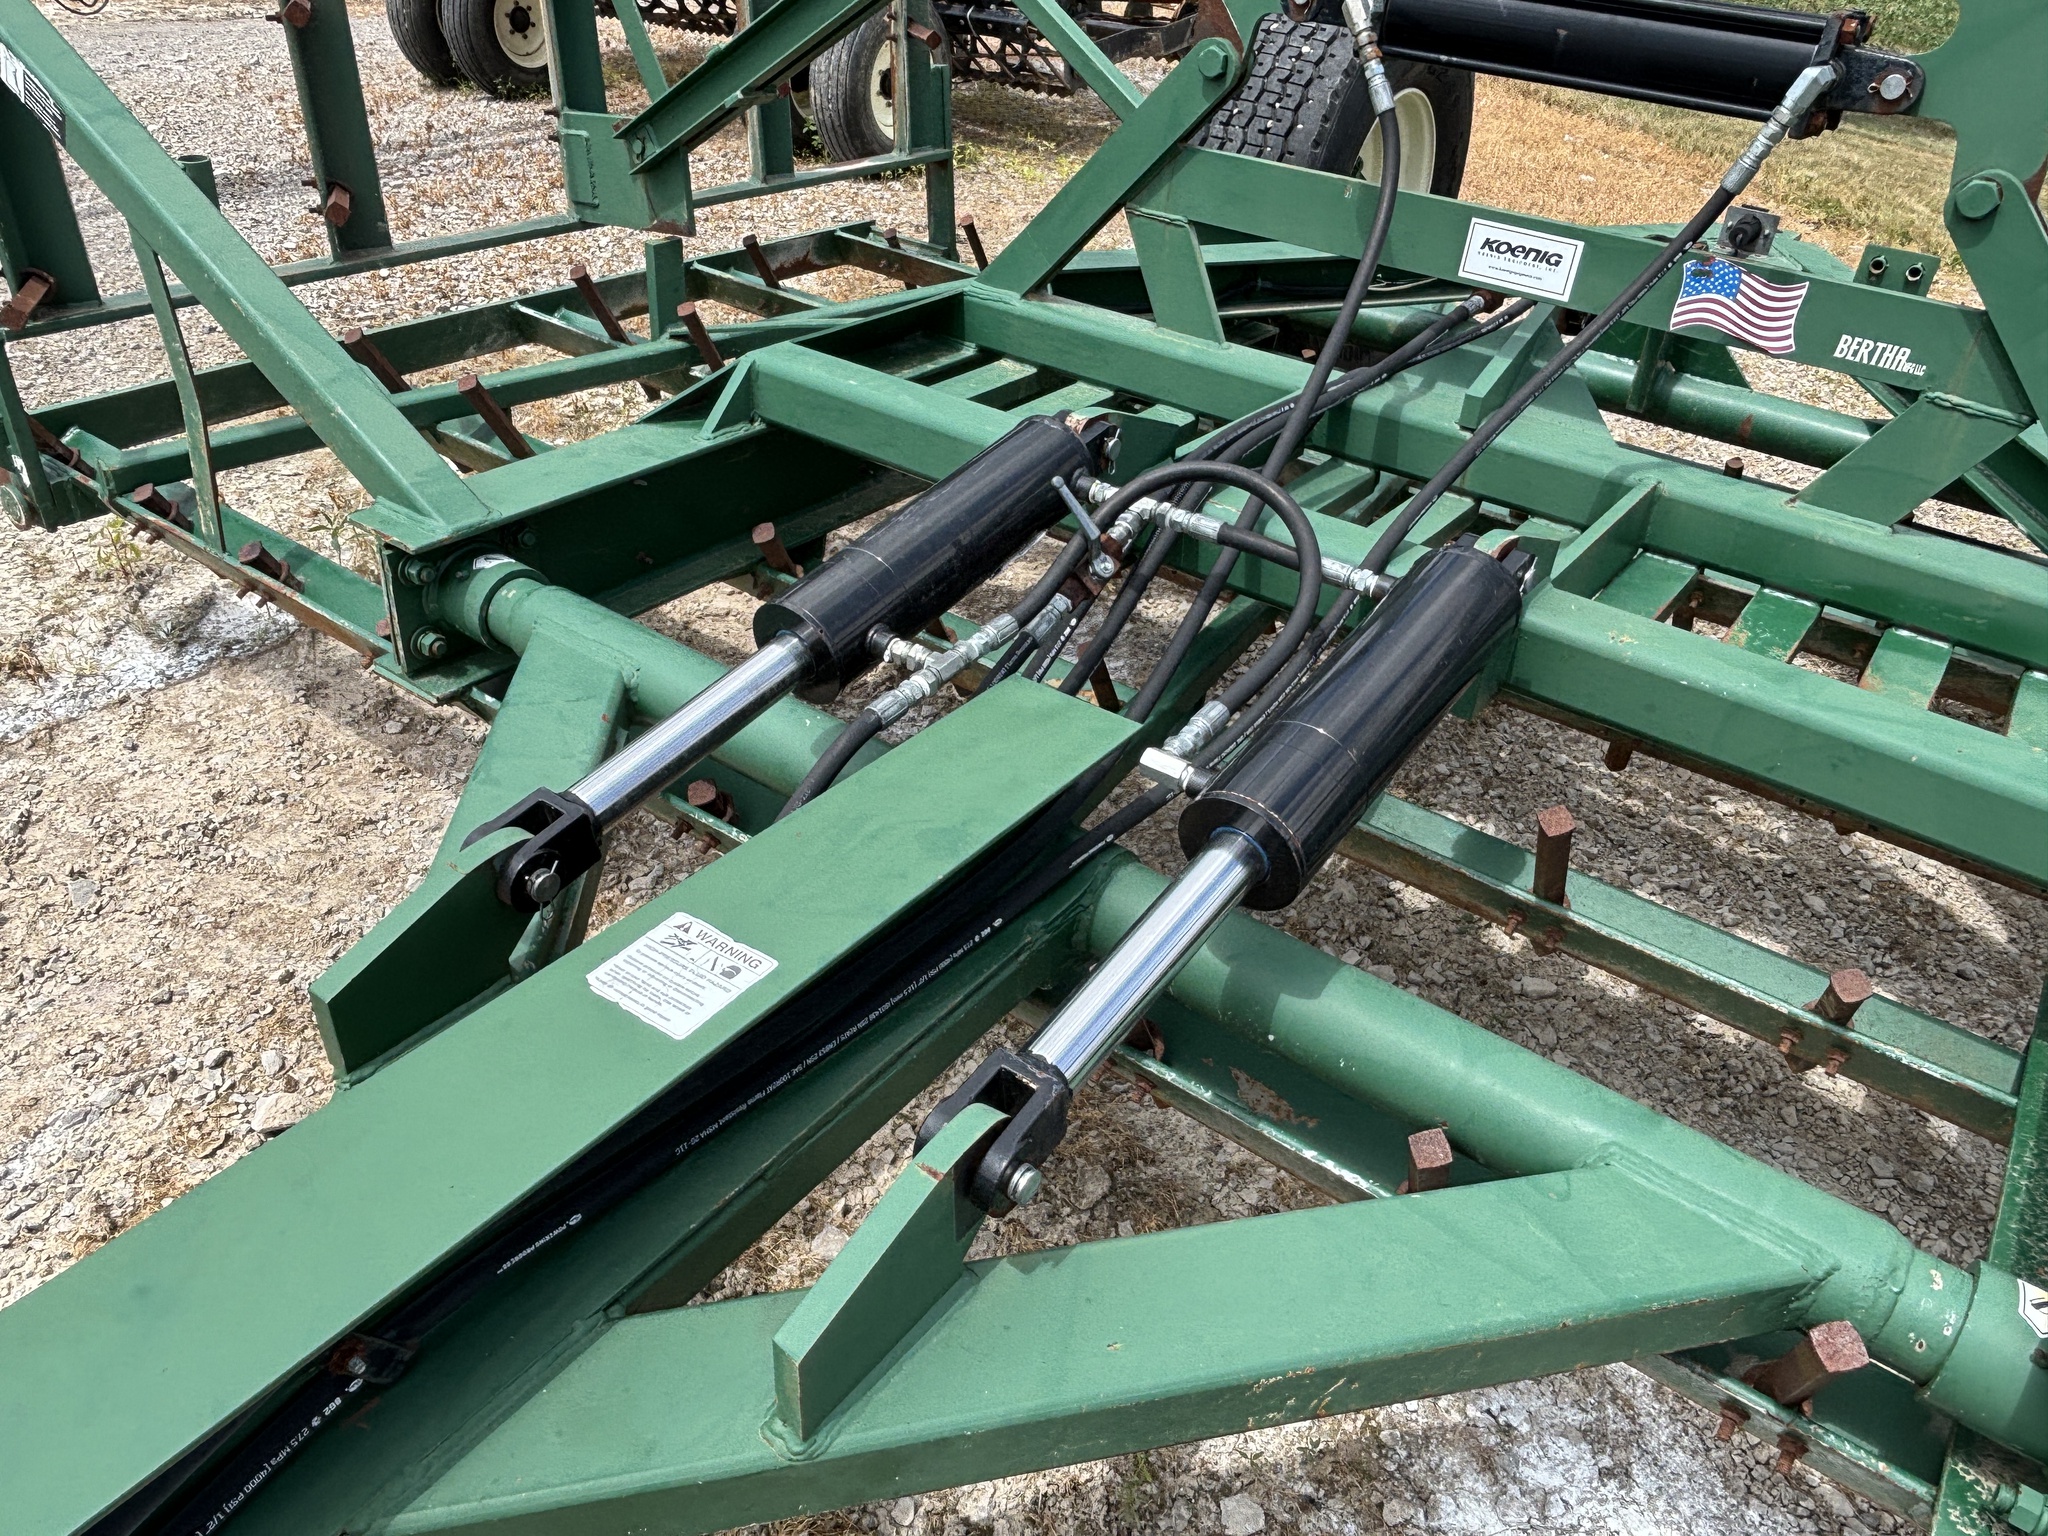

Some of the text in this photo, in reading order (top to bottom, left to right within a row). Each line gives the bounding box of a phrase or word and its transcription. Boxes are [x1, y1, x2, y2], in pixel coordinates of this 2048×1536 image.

[1833, 334, 1911, 372] BERTHA
[695, 929, 763, 970] WARNING
[268, 1444, 291, 1467] MPa
[240, 1461, 273, 1493] [4000
[221, 1489, 245, 1513] PSI]
